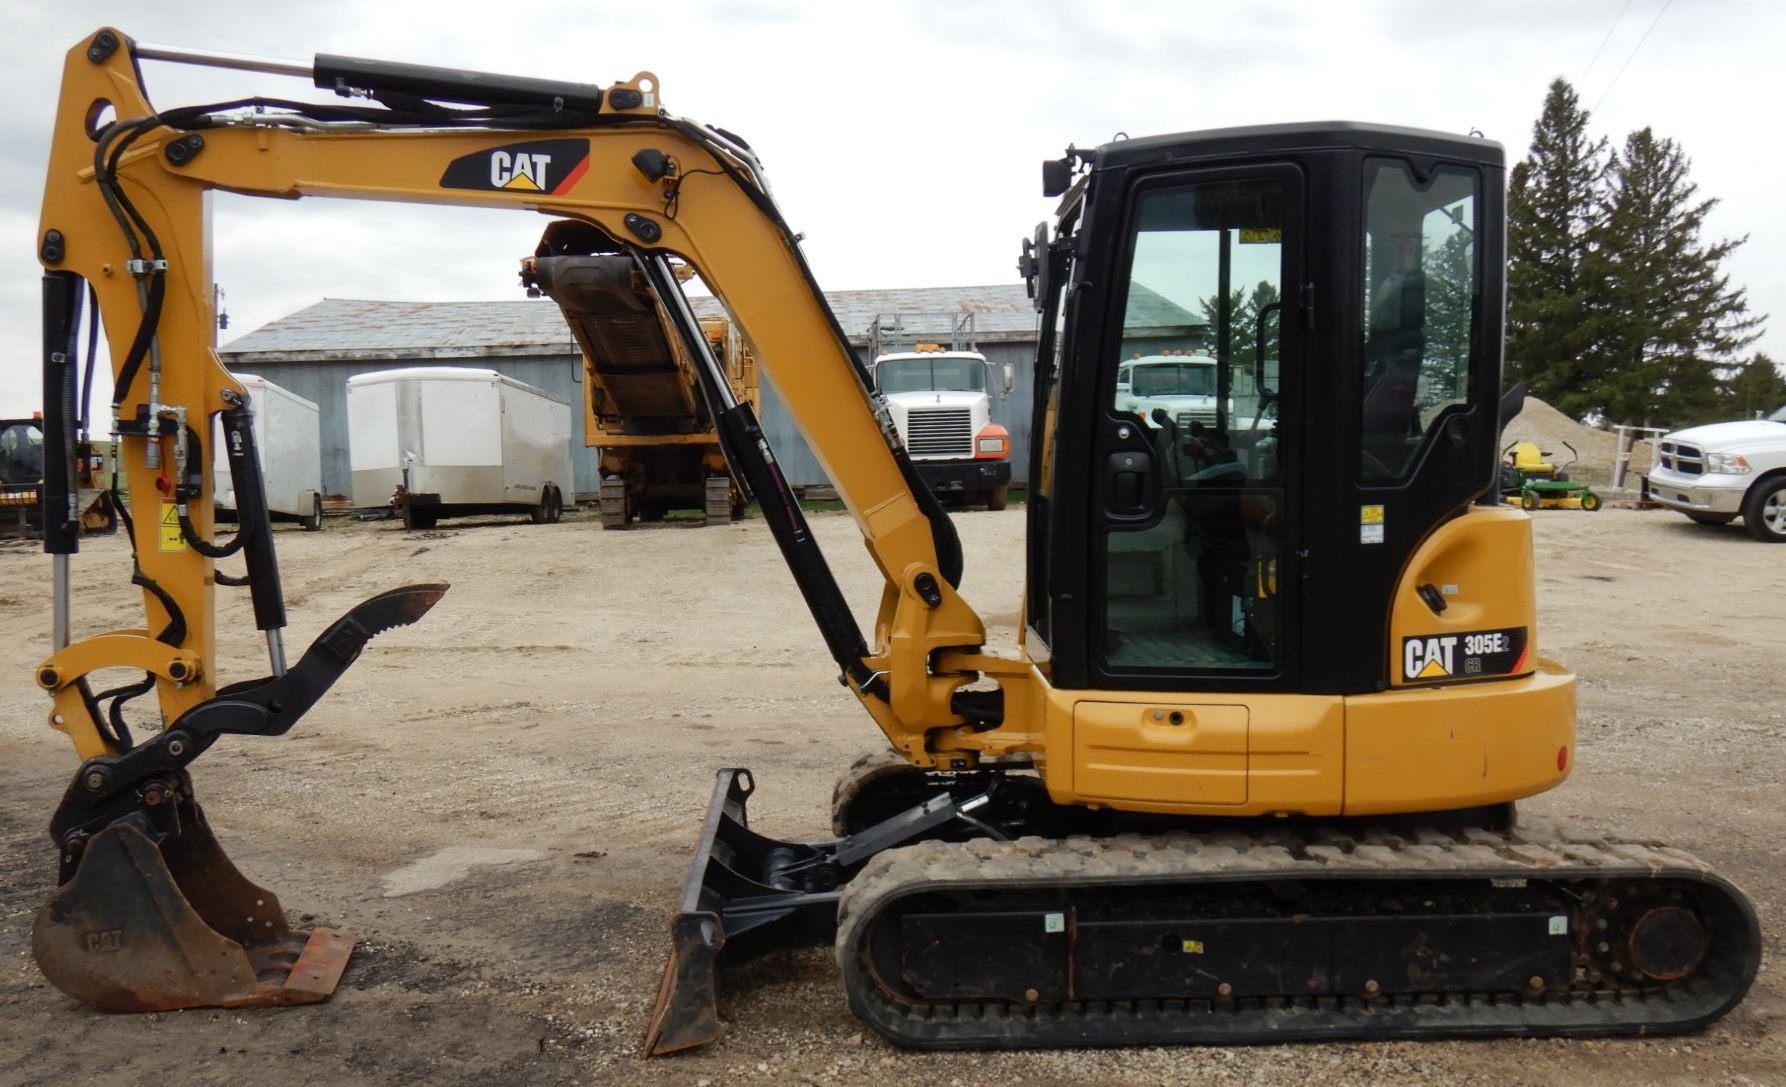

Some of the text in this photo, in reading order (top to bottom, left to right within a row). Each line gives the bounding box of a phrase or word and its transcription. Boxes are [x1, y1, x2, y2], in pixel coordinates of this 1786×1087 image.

[491, 151, 551, 190] CAT
[1405, 637, 1457, 678] CAT
[86, 930, 122, 952] CAT
